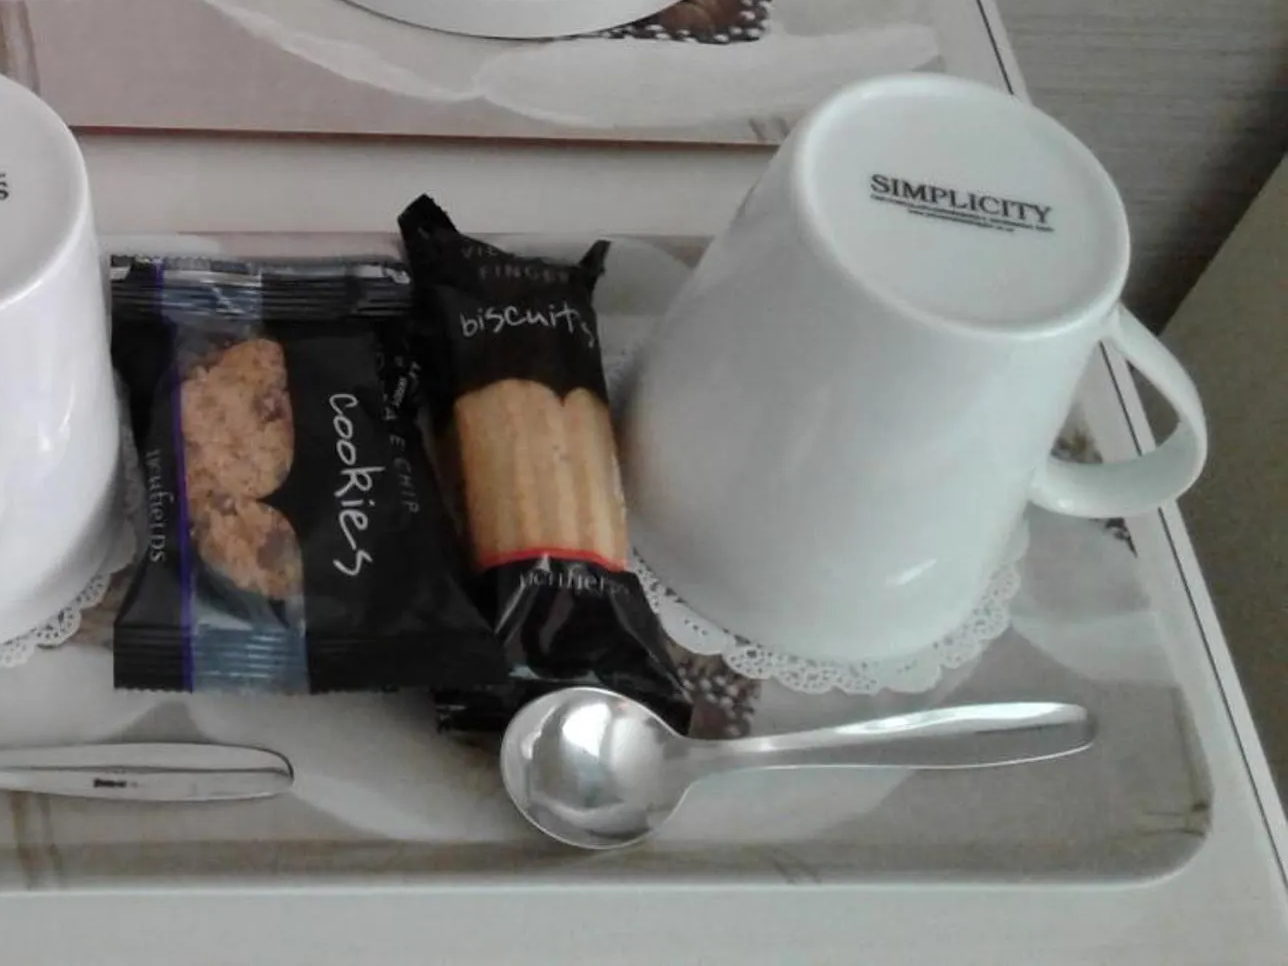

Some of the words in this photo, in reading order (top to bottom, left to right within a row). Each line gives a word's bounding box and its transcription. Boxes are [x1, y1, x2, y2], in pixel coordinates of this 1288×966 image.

[870, 173, 1052, 224] SIMPLICITY
[460, 299, 595, 348] biscuits
[328, 392, 385, 577] cookies
